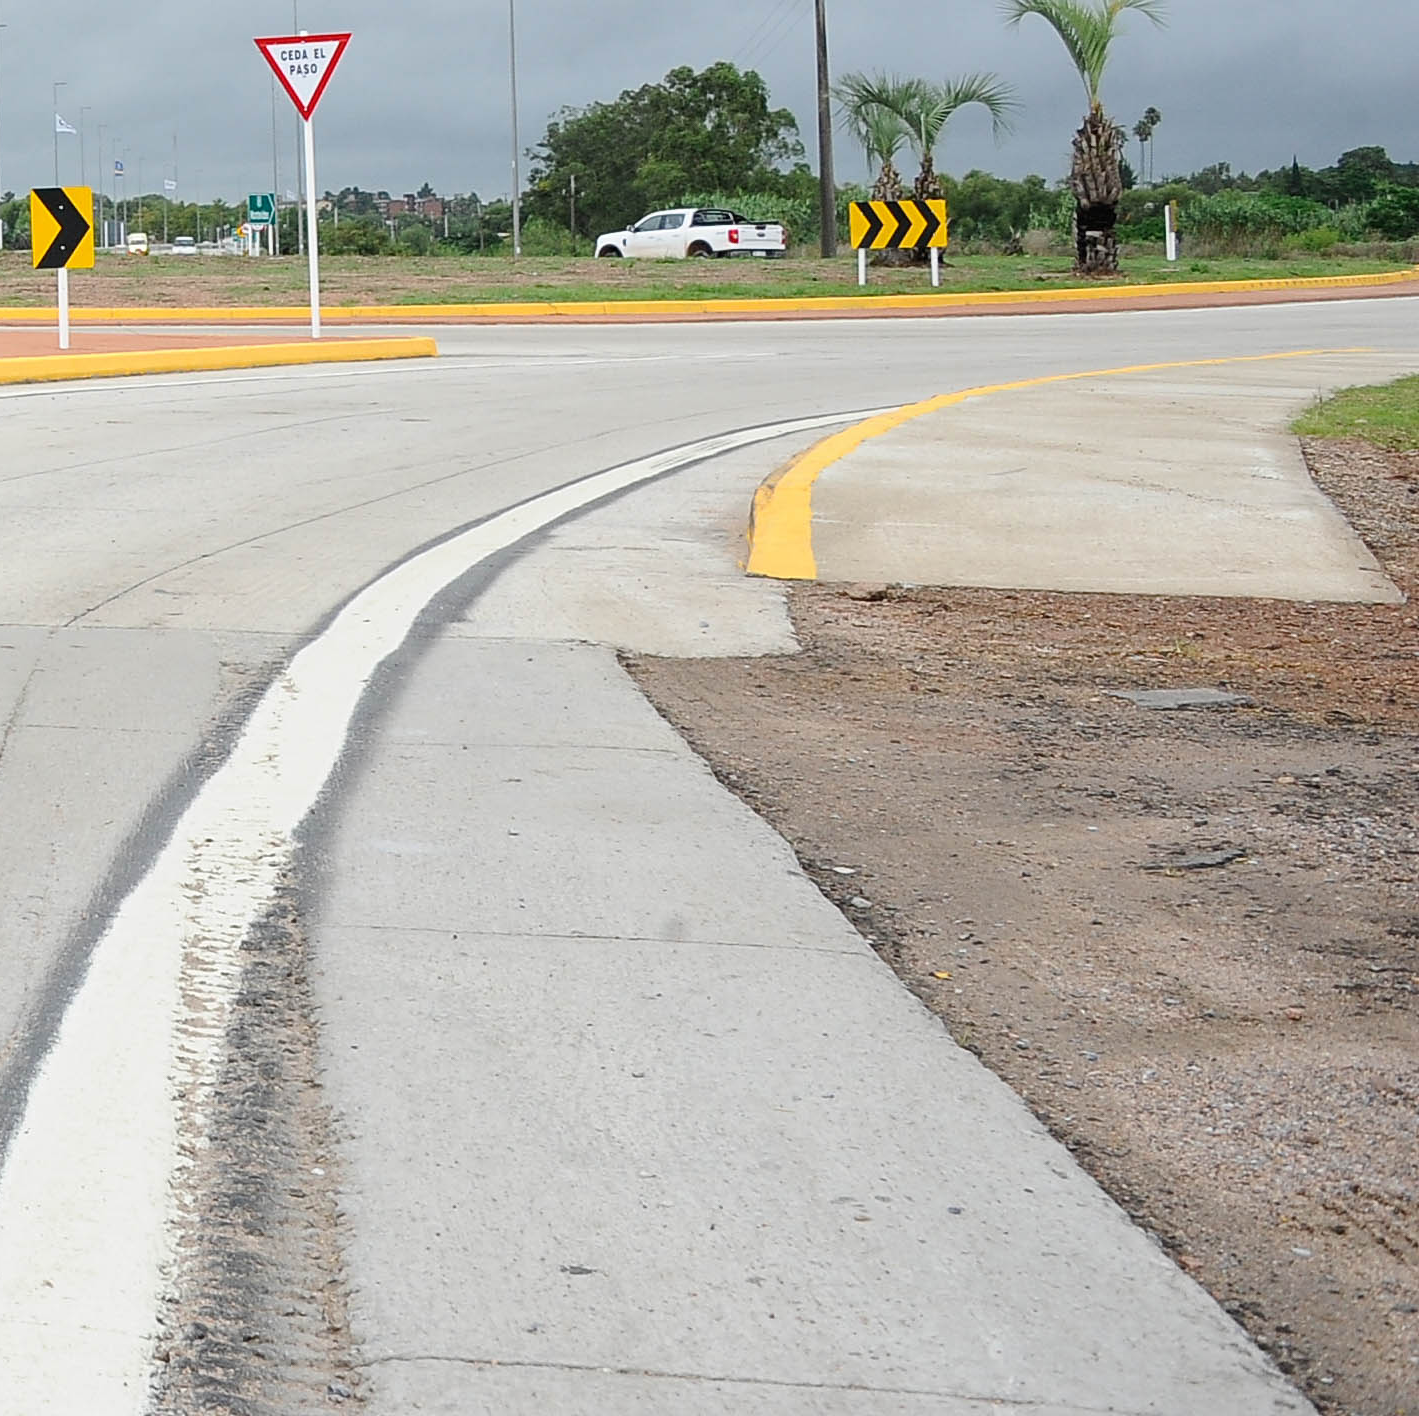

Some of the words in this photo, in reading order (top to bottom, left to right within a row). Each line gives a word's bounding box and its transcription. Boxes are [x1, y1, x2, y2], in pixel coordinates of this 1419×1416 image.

[280, 49, 308, 61] CEDA
[314, 48, 326, 59] EL
[289, 63, 318, 76] PASO
